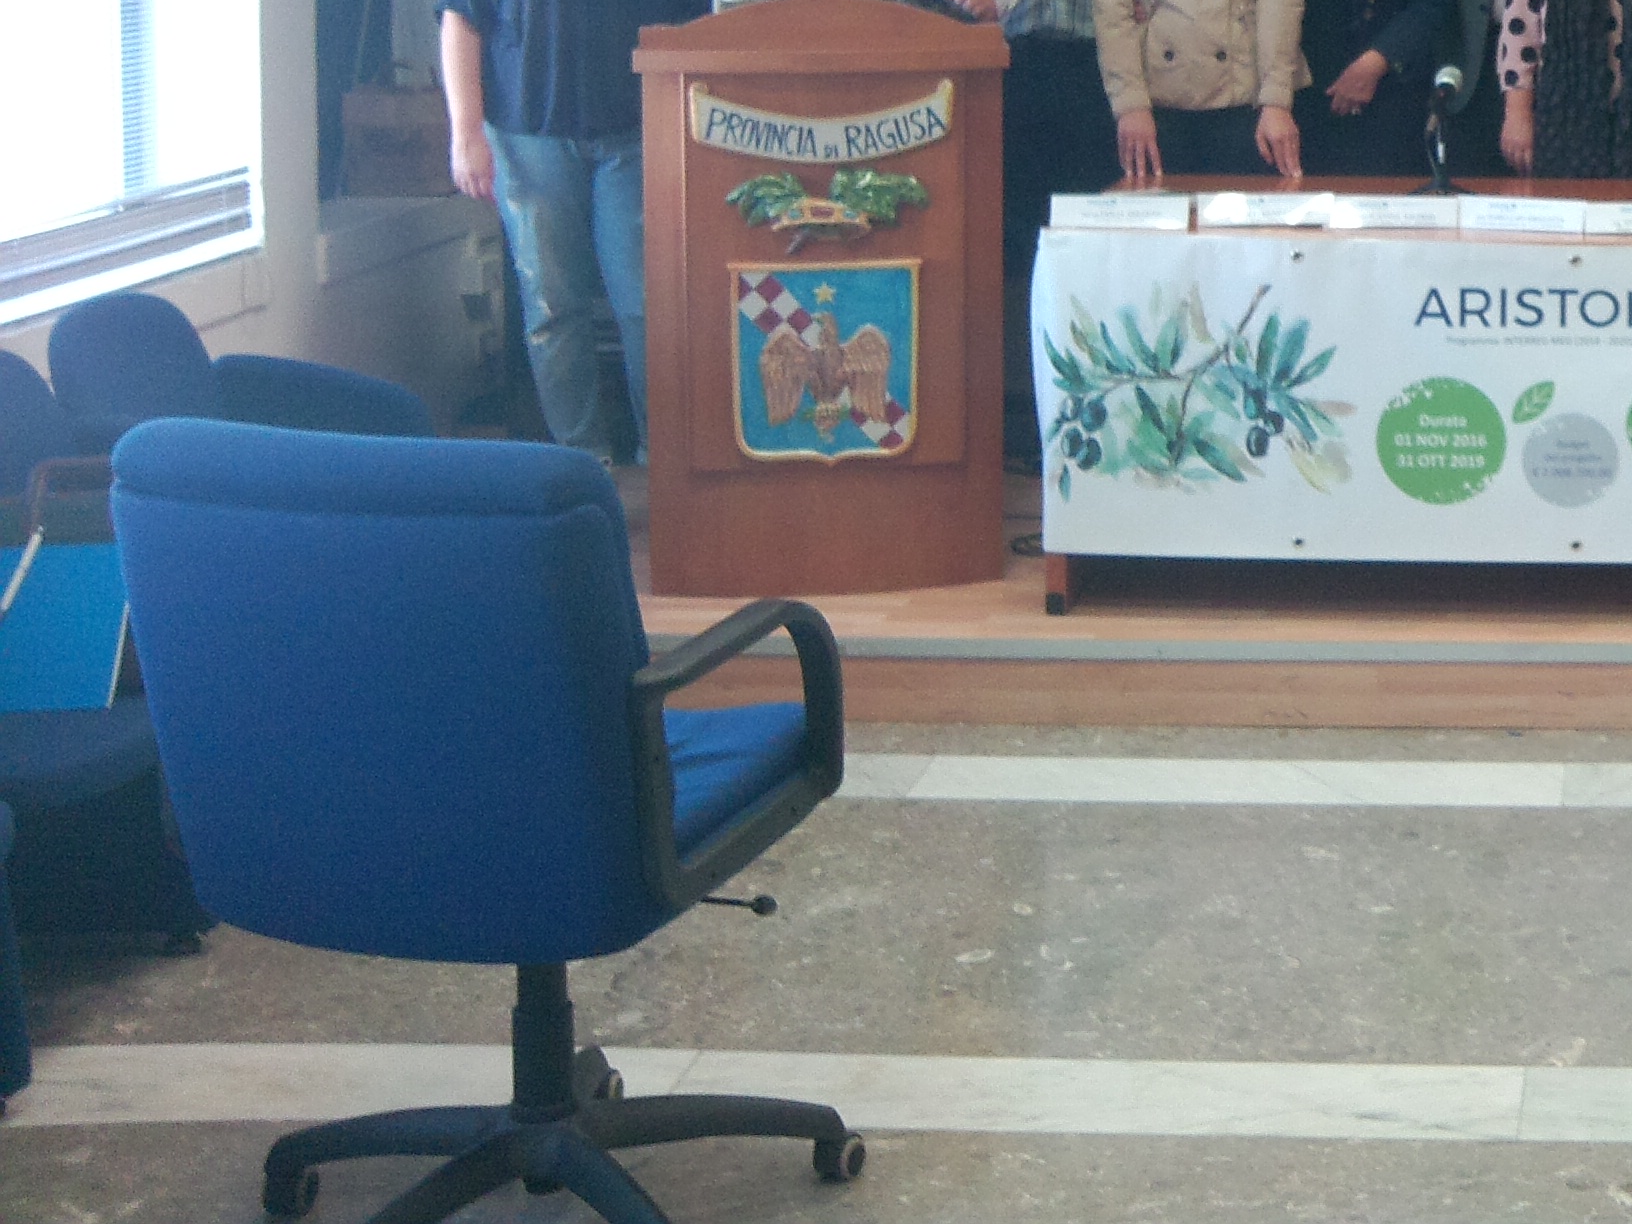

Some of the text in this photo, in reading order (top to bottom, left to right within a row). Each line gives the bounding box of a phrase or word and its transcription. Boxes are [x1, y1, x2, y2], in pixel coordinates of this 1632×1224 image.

[705, 107, 818, 158] PROVINCIA
[844, 105, 946, 158] RAGUSA
[1416, 434, 1448, 447] NOV
[1417, 455, 1445, 467] OTT
